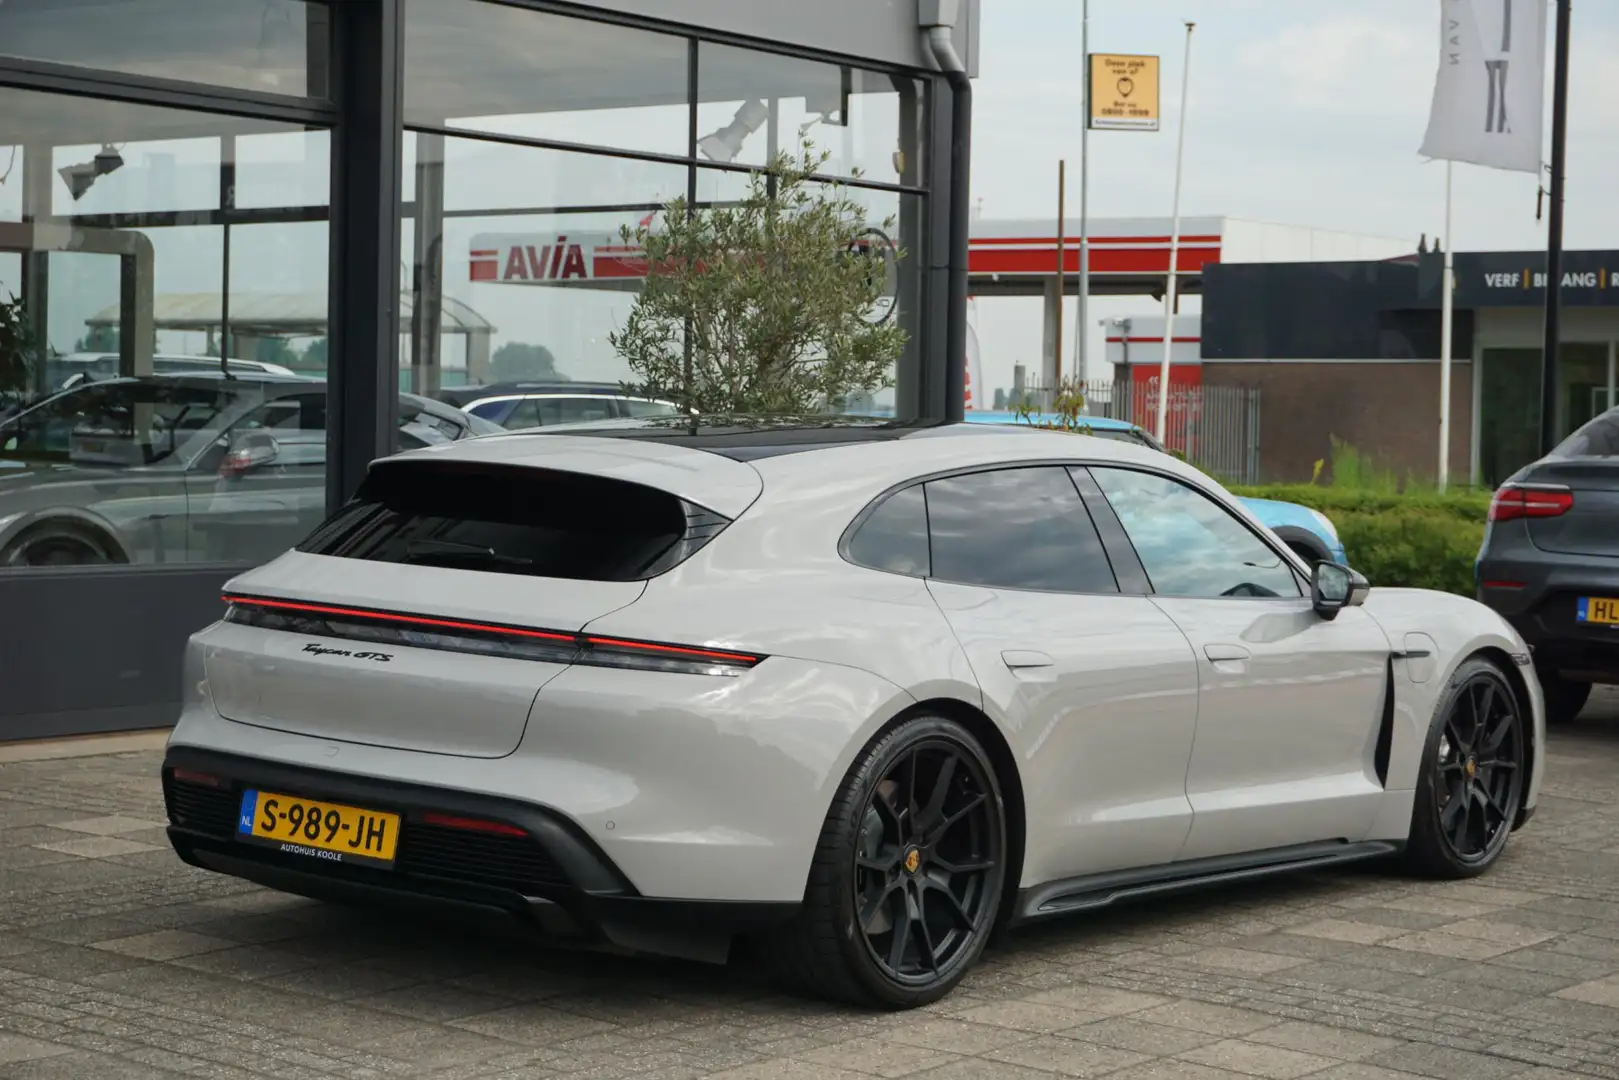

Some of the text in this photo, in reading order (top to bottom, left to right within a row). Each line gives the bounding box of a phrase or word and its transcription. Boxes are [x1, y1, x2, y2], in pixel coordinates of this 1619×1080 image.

[1484, 272, 1520, 288] VERF
[302, 643, 394, 662] Taycan GTS
[241, 815, 253, 827] NL
[260, 799, 386, 852] S-989-JH
[280, 843, 343, 861] AUTOHUIS KOOLE
